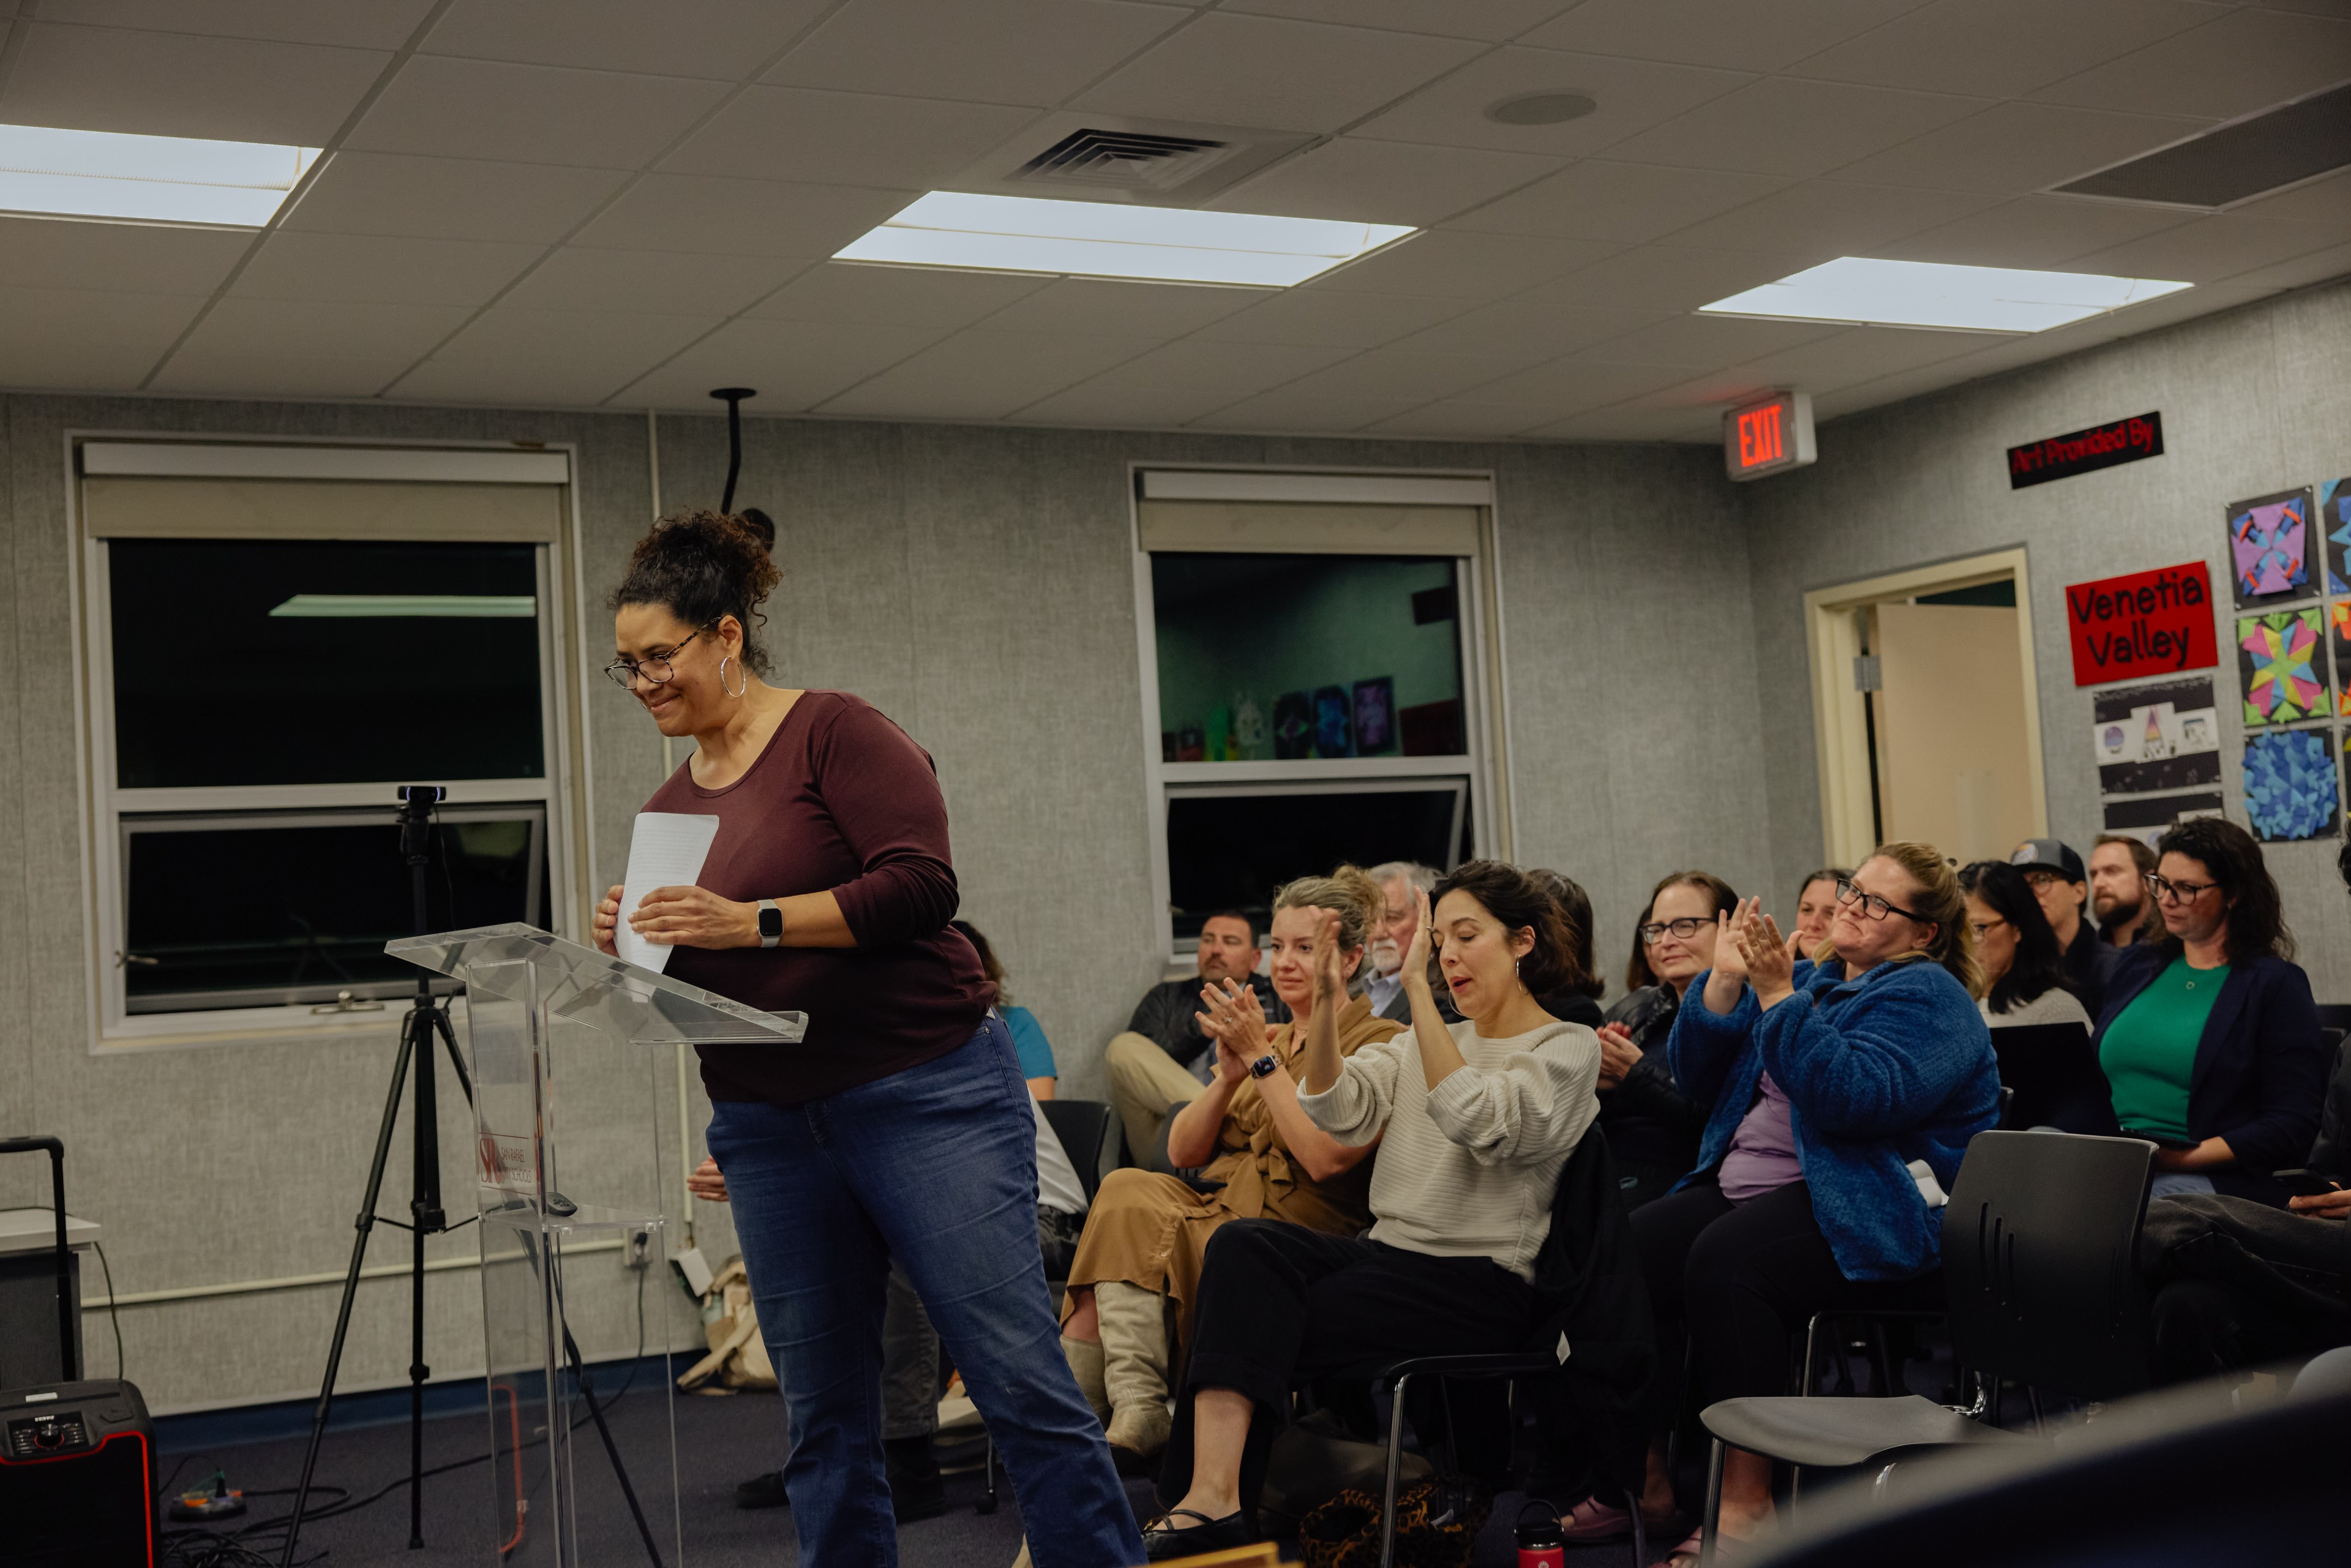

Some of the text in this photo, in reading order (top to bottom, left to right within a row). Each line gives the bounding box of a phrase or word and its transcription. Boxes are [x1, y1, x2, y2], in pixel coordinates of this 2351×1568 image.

[1738, 404, 1782, 468] EXIT
[2012, 417, 2154, 476] Art Provided By
[2071, 571, 2203, 625] Venetia
[2087, 618, 2189, 669] Valley
[501, 1147, 525, 1163] SAN RAFAEL
[511, 1166, 531, 1184] SCHOOLS
